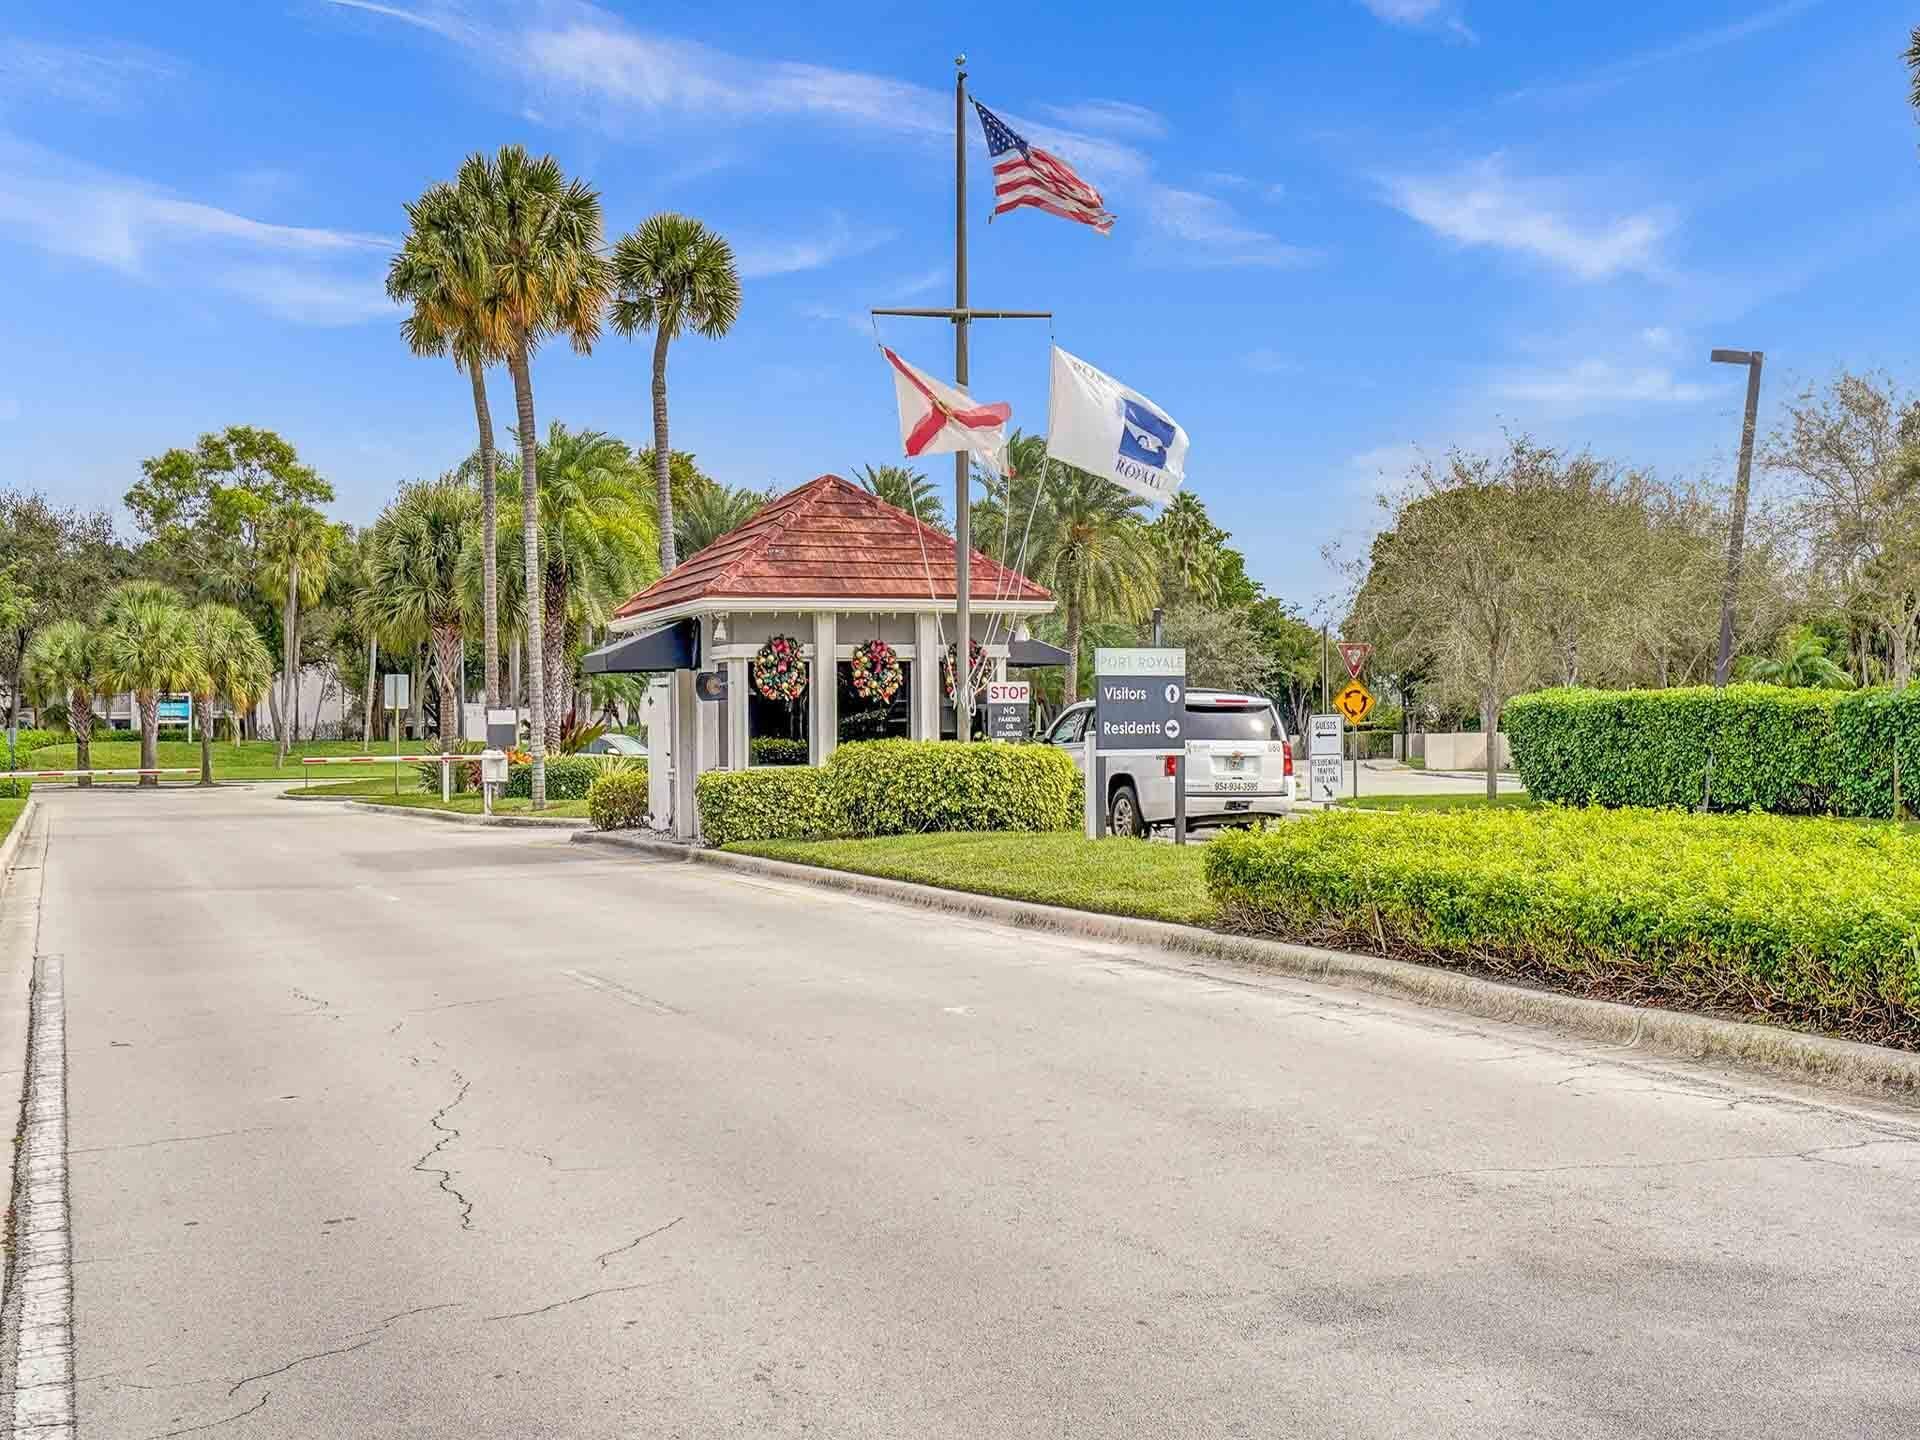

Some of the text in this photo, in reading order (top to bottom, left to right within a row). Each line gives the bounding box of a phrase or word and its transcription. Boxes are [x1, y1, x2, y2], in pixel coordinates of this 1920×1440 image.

[1101, 655, 1184, 669] PORT ROYALE
[991, 686, 1028, 700] STOP
[1104, 686, 1147, 700] Visitors
[1003, 706, 1016, 714] NO
[1103, 721, 1161, 735] Residents
[1315, 721, 1337, 730] GUESTS
[1317, 767, 1336, 775] TRAFFIC
[1314, 775, 1339, 784] THIS LANE
